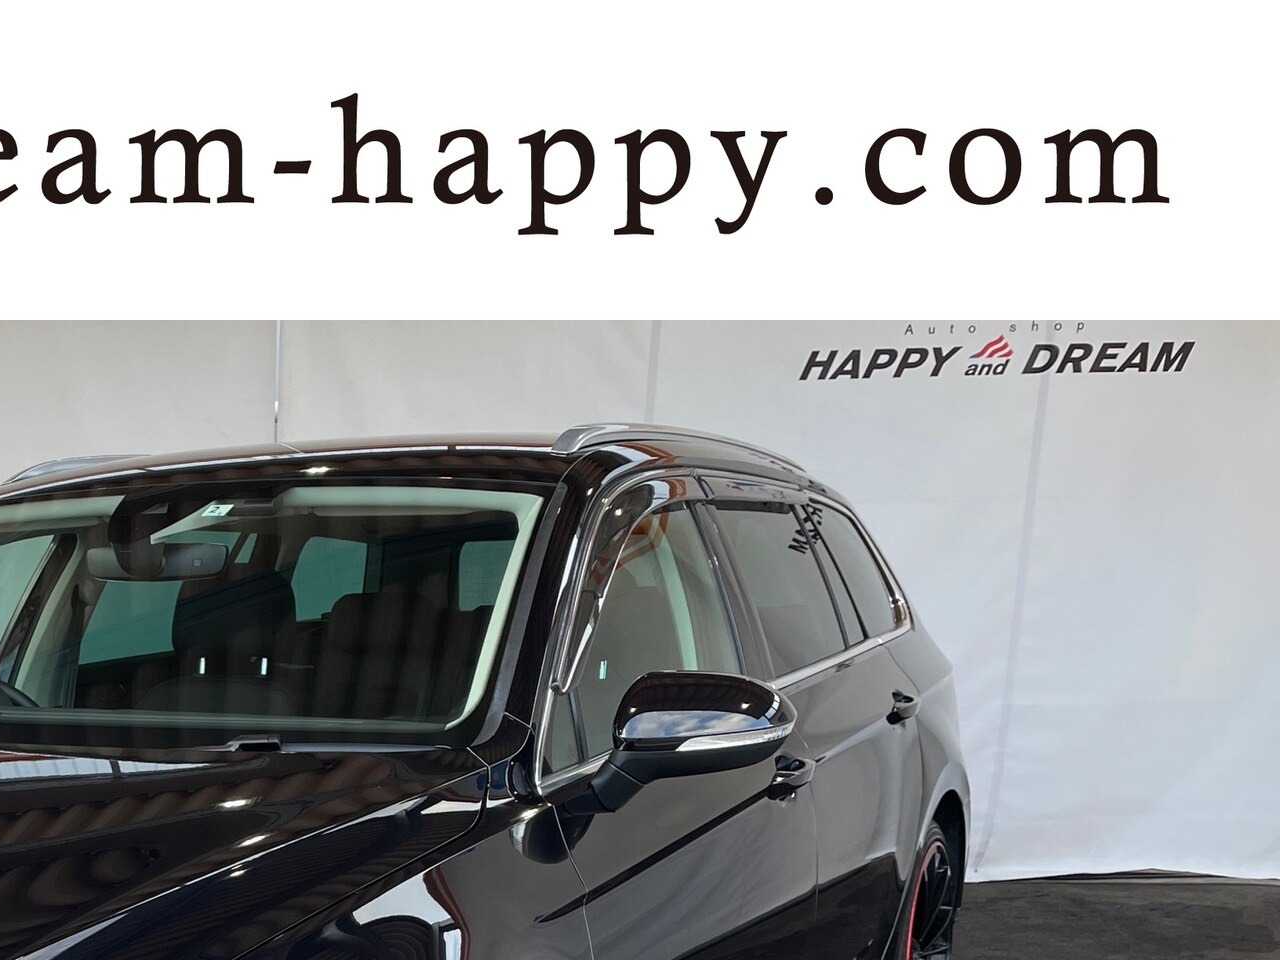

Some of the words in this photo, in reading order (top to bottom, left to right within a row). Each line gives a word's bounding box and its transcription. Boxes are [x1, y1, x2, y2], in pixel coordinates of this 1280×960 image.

[903, 322, 978, 336] Auto
[1008, 320, 1086, 334] shop
[798, 345, 964, 381] HAPPY
[964, 358, 1010, 376] and
[1021, 341, 1197, 375] DREAM
